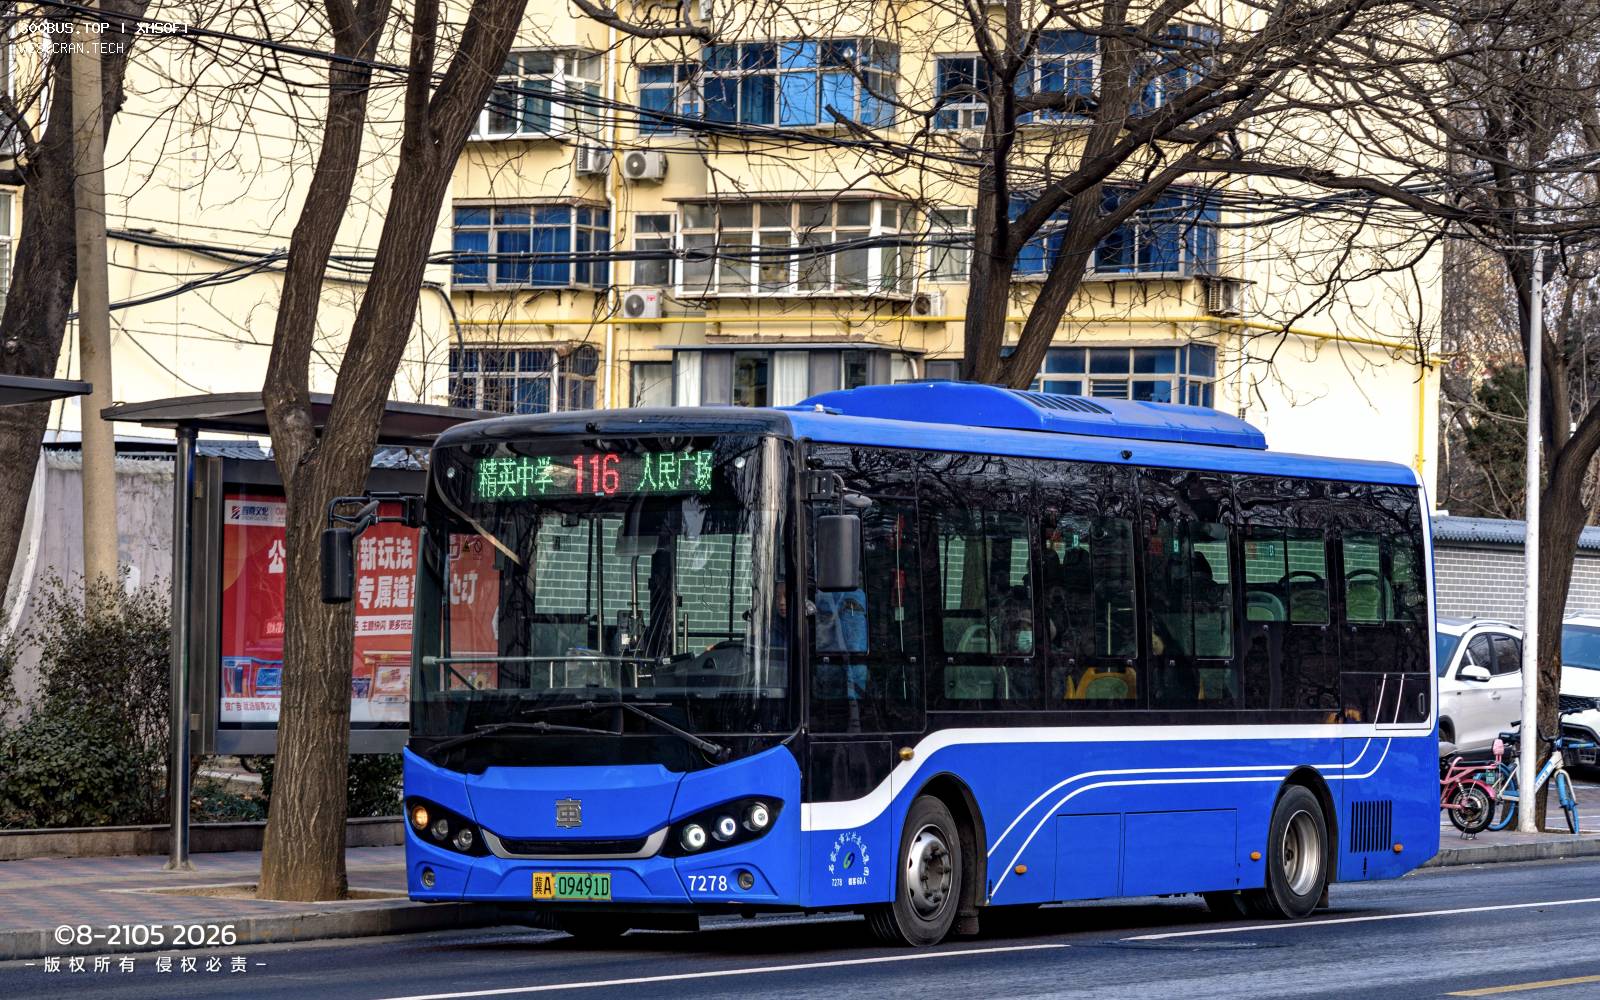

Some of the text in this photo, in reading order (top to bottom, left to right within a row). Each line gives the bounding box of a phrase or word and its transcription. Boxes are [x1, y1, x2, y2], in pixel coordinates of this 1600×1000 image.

[478, 451, 713, 497] 精英中学 116 人民广场
[360, 536, 413, 571] 新玩法
[558, 876, 609, 896] 09491D
[688, 875, 728, 892] 7278
